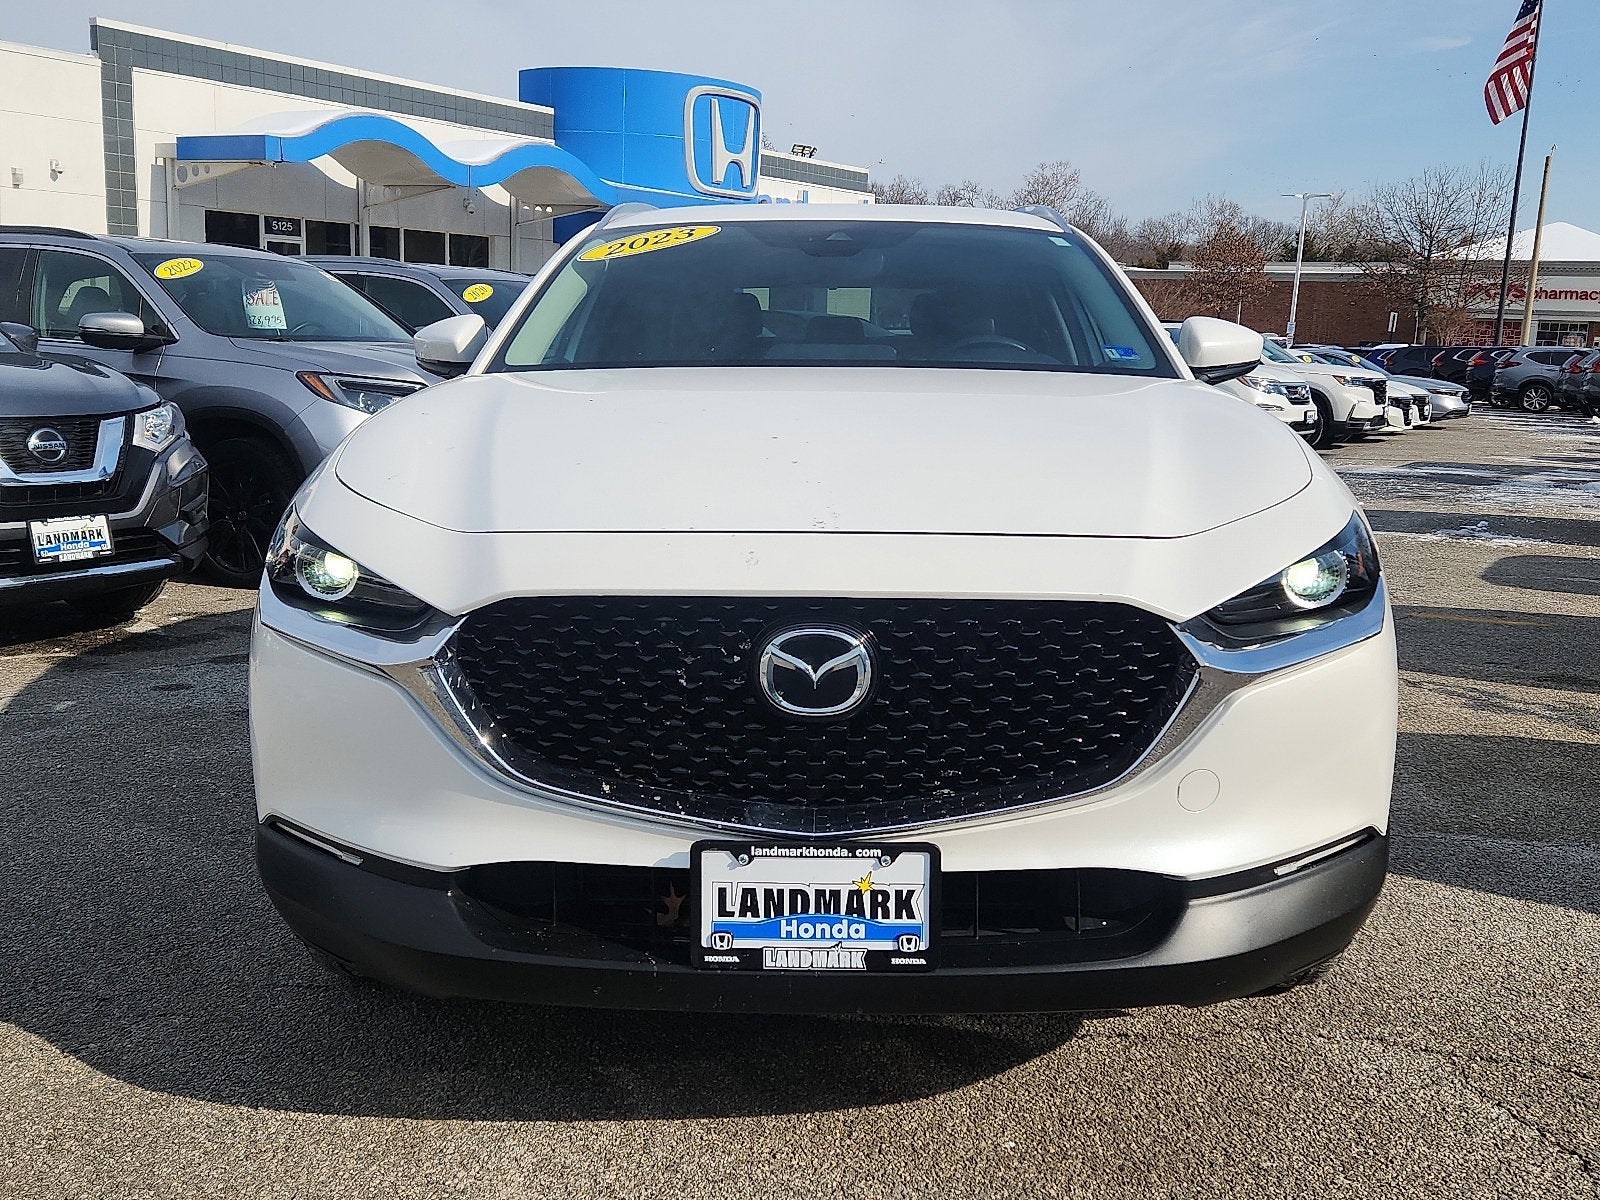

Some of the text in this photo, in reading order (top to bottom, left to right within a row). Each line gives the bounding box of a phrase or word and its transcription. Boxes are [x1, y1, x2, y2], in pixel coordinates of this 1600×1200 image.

[272, 221, 293, 231] 5125
[607, 228, 696, 257] 2023
[163, 260, 196, 276] 2022
[247, 290, 279, 306] SALE
[1534, 287, 1600, 303] harmac
[37, 528, 104, 547] LANDMARK
[60, 542, 90, 551] Honda
[750, 845, 882, 858] landmarkhonda. com
[717, 886, 917, 921] LANDMARK
[780, 919, 867, 940] Honda
[704, 955, 740, 963] HONDA
[764, 949, 866, 969] LANDMARK
[891, 957, 927, 965] HONDA
